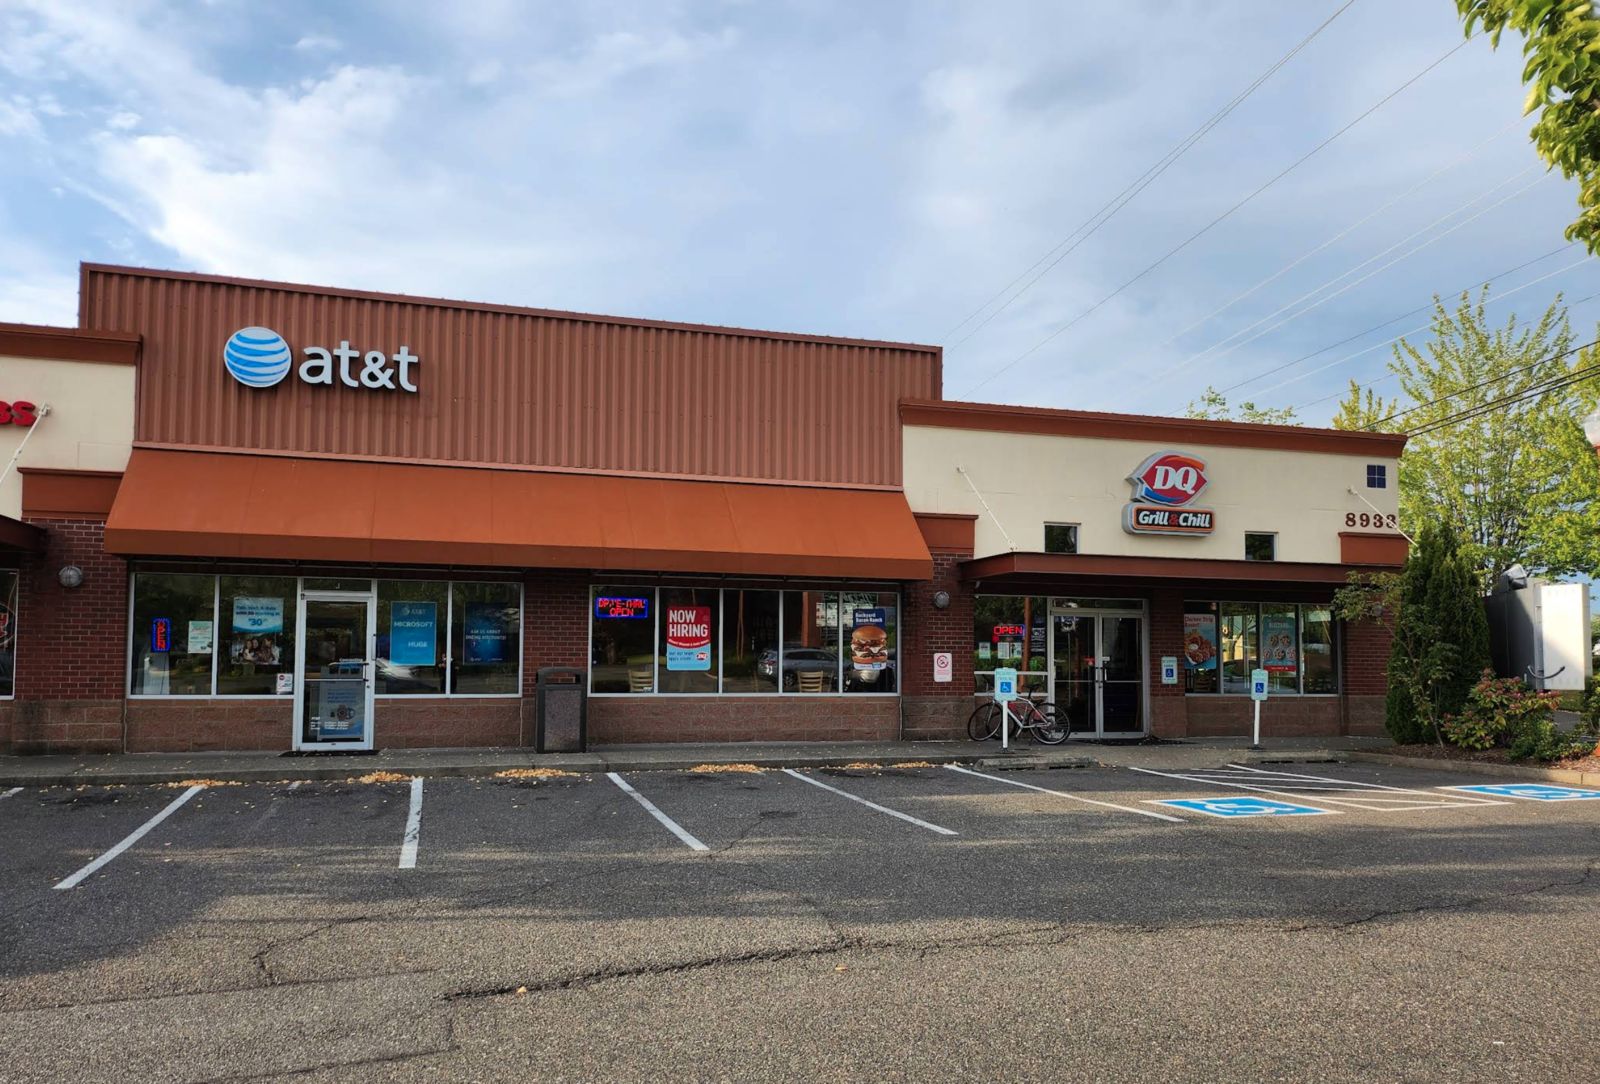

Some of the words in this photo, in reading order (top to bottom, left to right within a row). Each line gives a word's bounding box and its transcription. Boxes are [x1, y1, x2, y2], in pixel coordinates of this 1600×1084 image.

[299, 340, 418, 392] at&t
[1153, 465, 1197, 494] DQ
[1138, 511, 1169, 525] Grill
[1179, 513, 1211, 527] Chill
[1345, 512, 1397, 529] 8933
[609, 607, 634, 617] OPEN
[669, 609, 696, 623] NOW
[669, 624, 708, 638] HIRING
[993, 625, 1023, 635] OPEN
